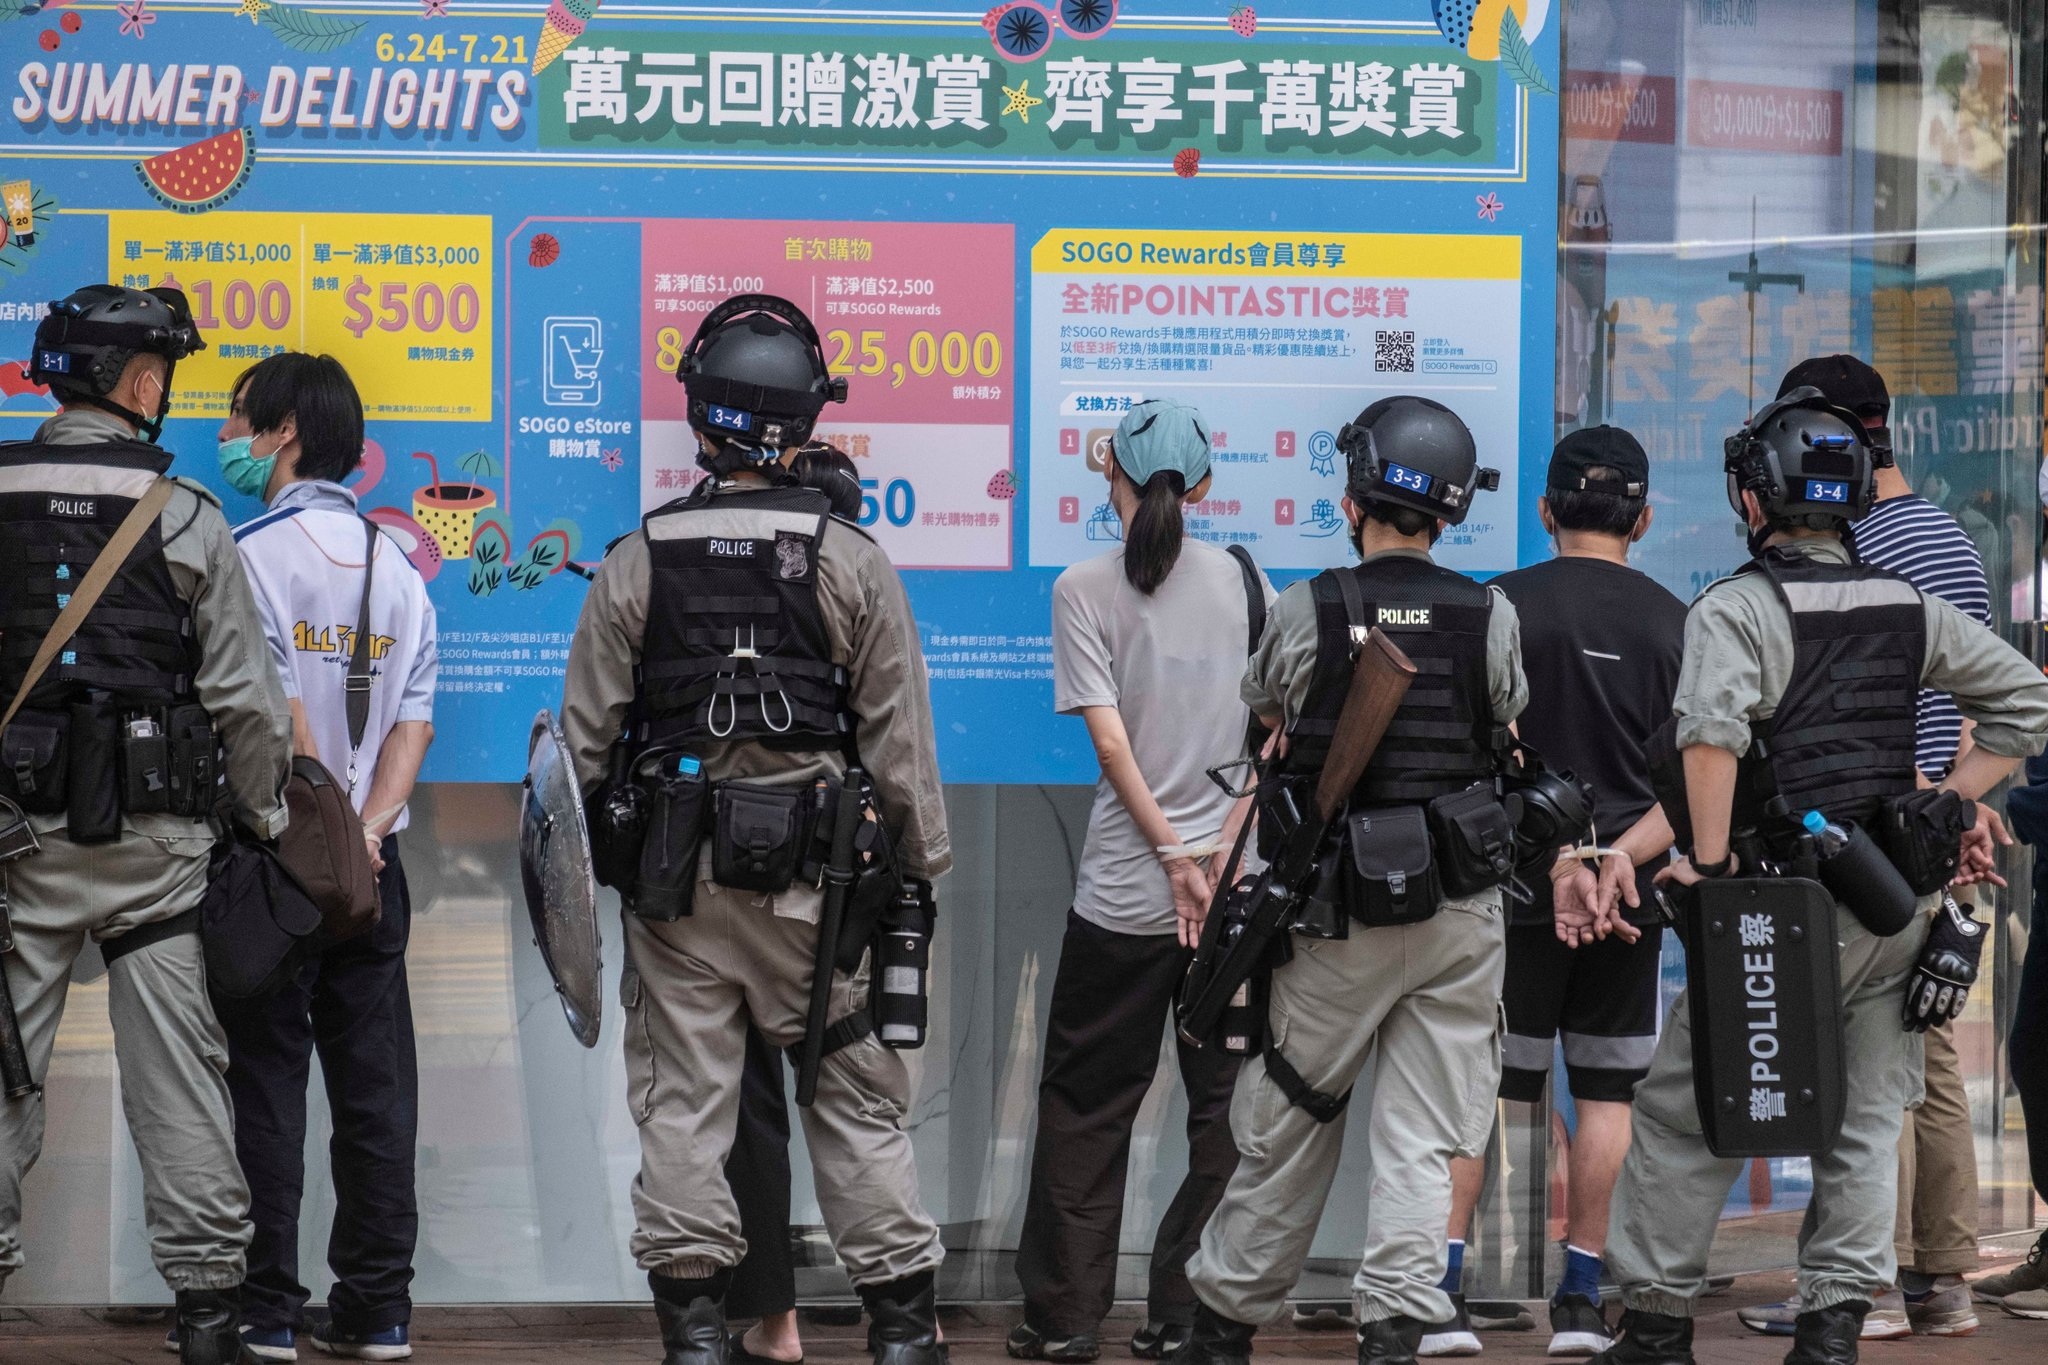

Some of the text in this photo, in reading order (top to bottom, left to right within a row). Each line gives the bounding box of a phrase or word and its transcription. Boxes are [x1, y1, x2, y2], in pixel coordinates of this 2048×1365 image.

[376, 33, 529, 64] 6.24-7.21
[12, 61, 528, 131] SUMMER DELIGHTS
[563, 46, 991, 130] 萬元回贈激賞
[1044, 56, 1466, 139] 齊享千萬獎賞
[16, 217, 29, 226] 20
[124, 240, 292, 265] 單一滿淨值$1,000
[312, 243, 480, 268] 單一滿淨值$3,000
[784, 236, 873, 262] 首次購物
[1062, 241, 1347, 268] SOGO Rewards會員尊享
[123, 273, 150, 289] 換領
[312, 276, 339, 291] 換領
[654, 273, 765, 296] 滿淨值$1,000
[825, 276, 935, 298] 滿淨值$2,500
[342, 274, 480, 338] $500
[825, 301, 942, 316] 可享SOGO Rewards
[1061, 282, 1410, 319] 全新POINTASTIC獎賞
[1060, 325, 1107, 339] 於SOGO
[43, 354, 64, 370] 3-1
[408, 346, 475, 361] 購物現金券
[825, 329, 1002, 389] 25,000
[1425, 362, 1480, 370] SOGO Rewards
[952, 385, 1002, 400] 額外積分
[519, 416, 632, 435] SOGO eStore
[715, 408, 743, 428] 3-4
[549, 439, 601, 459] 購物賞
[1066, 435, 1074, 447] 1
[1281, 437, 1289, 450] 2
[1393, 469, 1422, 489] 3-3
[1814, 484, 1842, 500] 3-4
[51, 500, 94, 515] POLICE
[1065, 503, 1073, 515] 3
[1280, 505, 1289, 518] 4
[921, 511, 1001, 527] 崇光購物禮券
[710, 540, 753, 556] POLICE
[1377, 608, 1430, 624] POLICE
[292, 620, 336, 652] ALL
